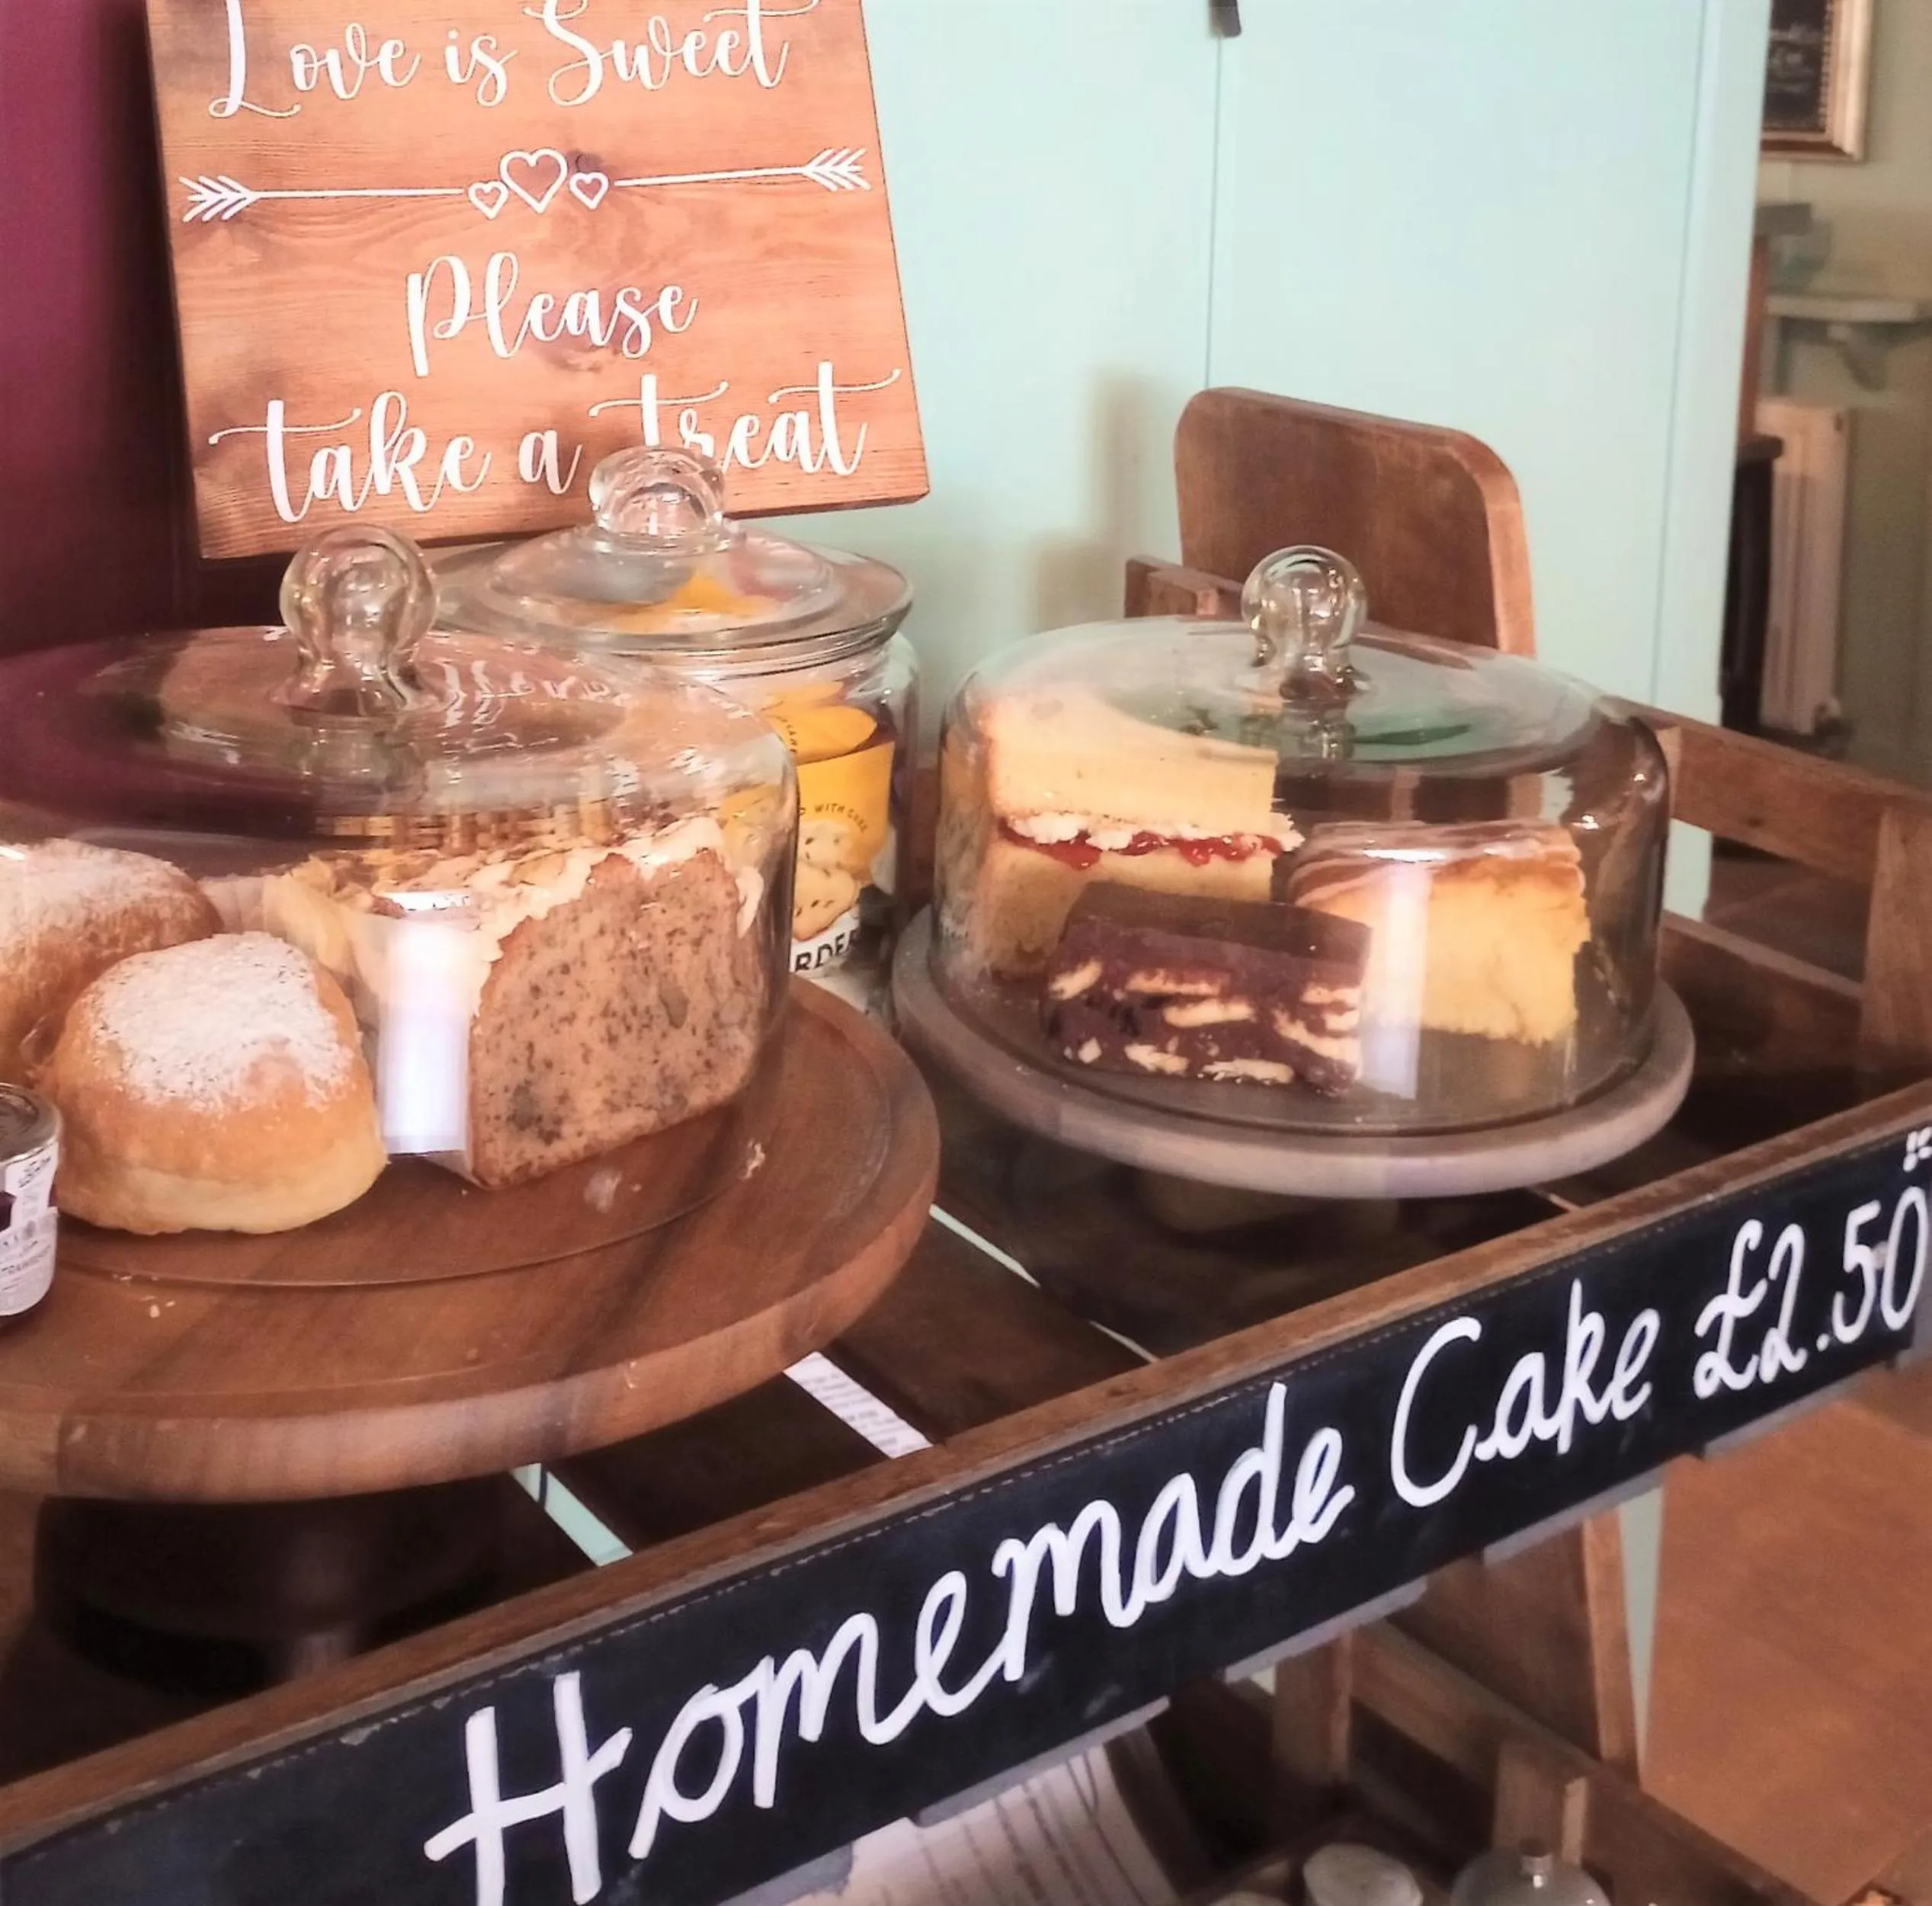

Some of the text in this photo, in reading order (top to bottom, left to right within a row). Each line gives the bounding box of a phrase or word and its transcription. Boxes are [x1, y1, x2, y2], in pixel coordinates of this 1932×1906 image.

[208, 0, 819, 117] Love is Sweet
[405, 251, 698, 377] Please
[208, 391, 492, 523] take
[518, 429, 582, 494] a
[814, 803, 845, 813] WITH
[424, 1382, 1355, 1906] Homemade
[1390, 1280, 1659, 1507] Cake
[1693, 1186, 1928, 1398] £2.50
